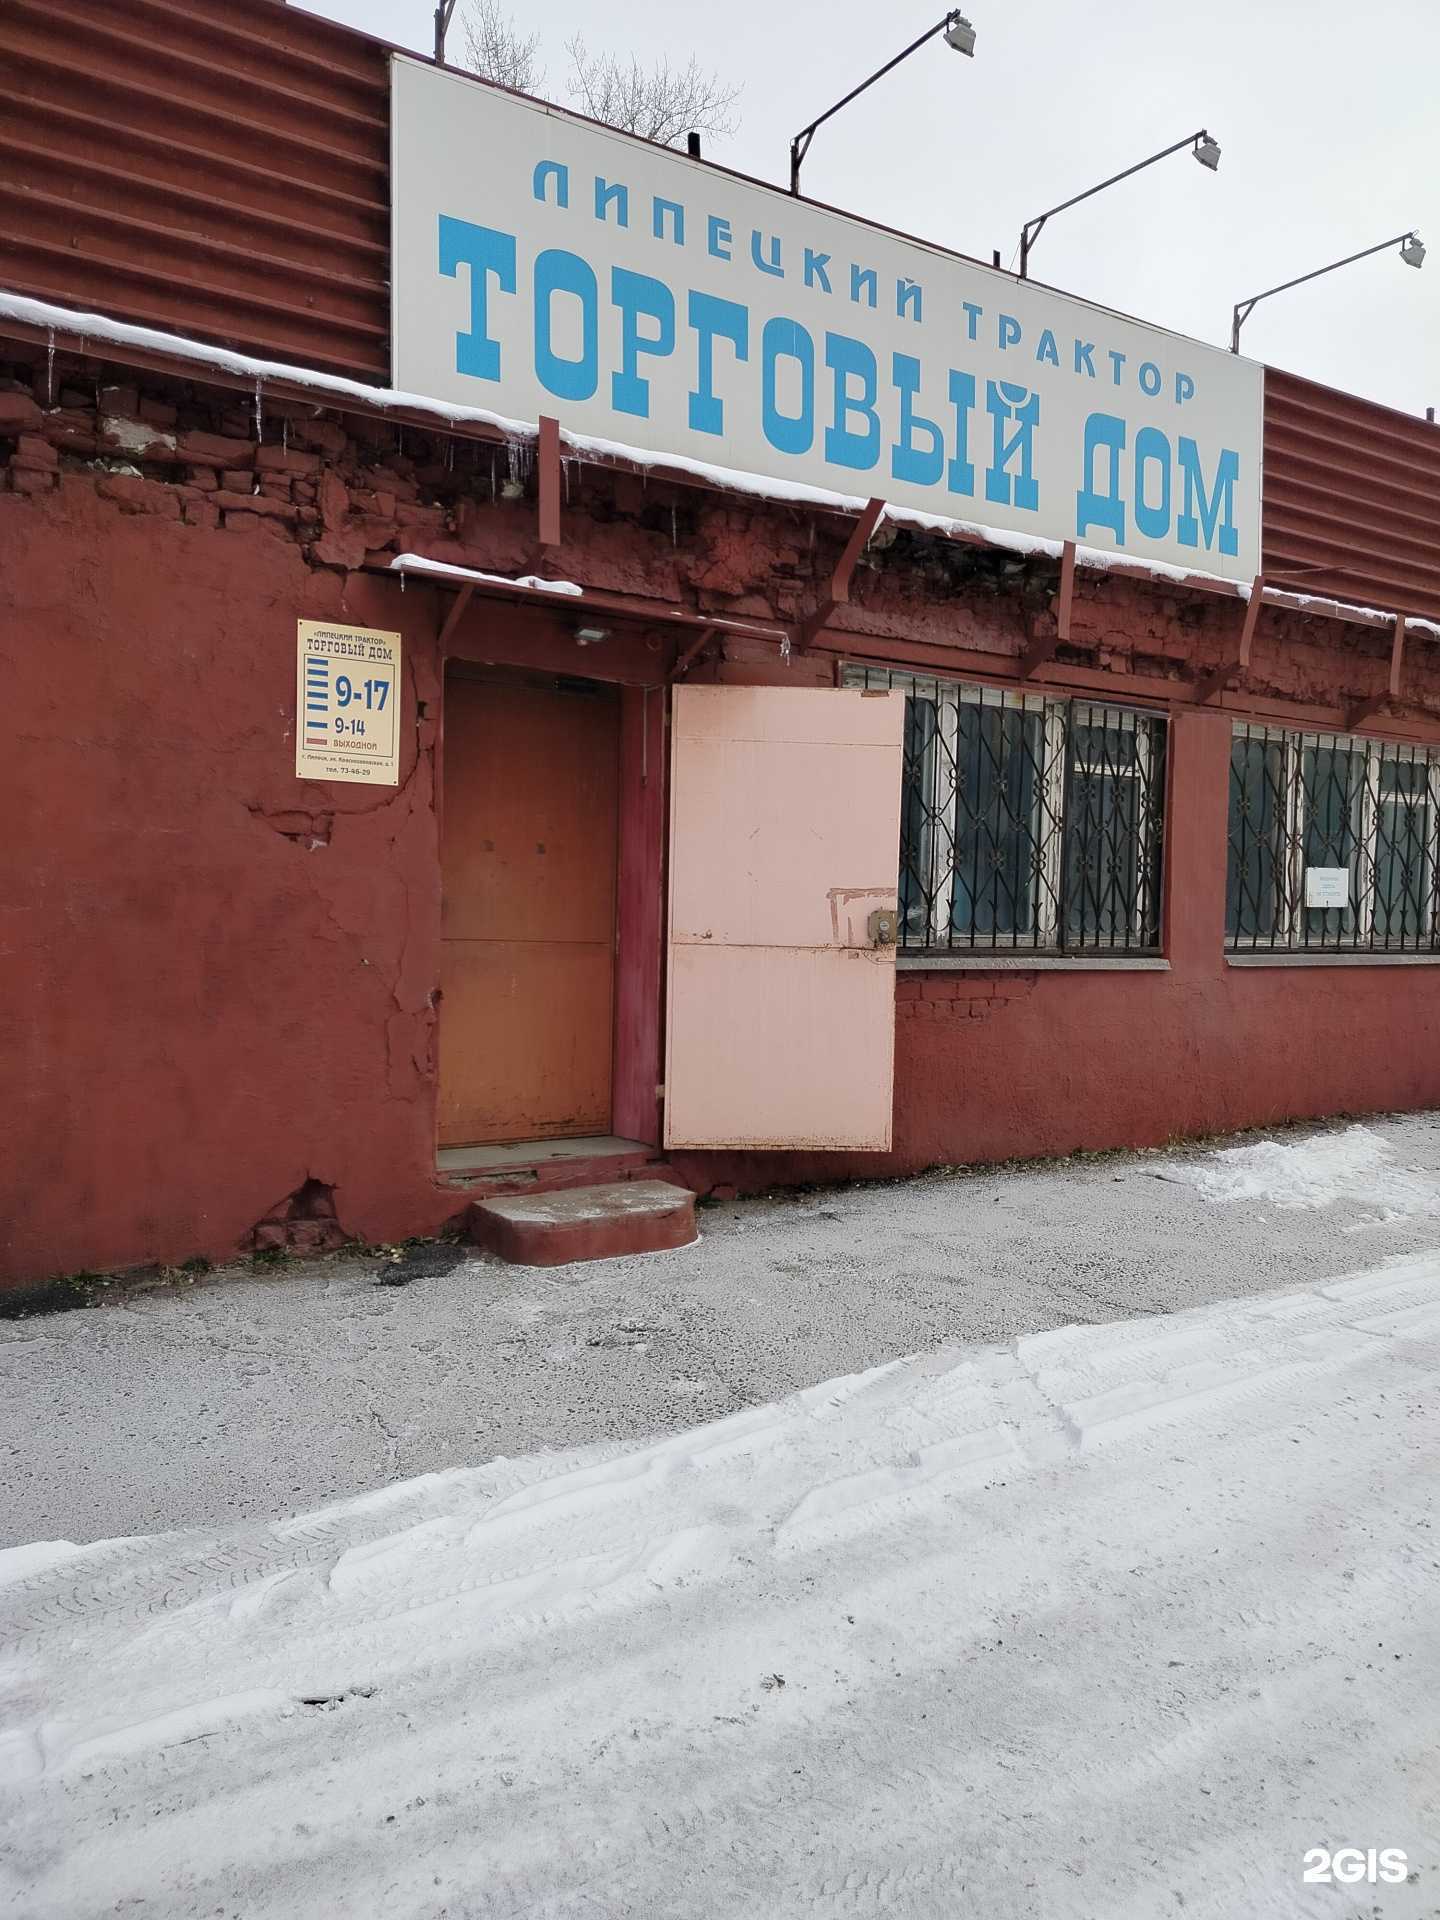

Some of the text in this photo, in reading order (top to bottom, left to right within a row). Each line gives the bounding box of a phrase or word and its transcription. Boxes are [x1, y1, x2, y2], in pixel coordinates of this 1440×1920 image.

[533, 161, 1195, 404] ЛИПЕЦКИЙ ТРАКТОР
[437, 215, 1239, 556] ТОРГОВЫЙ ДОМ
[307, 638, 393, 660] ТОРГОВЫЙ ДОМ
[335, 675, 389, 710] 9-17
[335, 717, 365, 736] 9-14
[333, 739, 377, 750] ВЫХОДНОЙ
